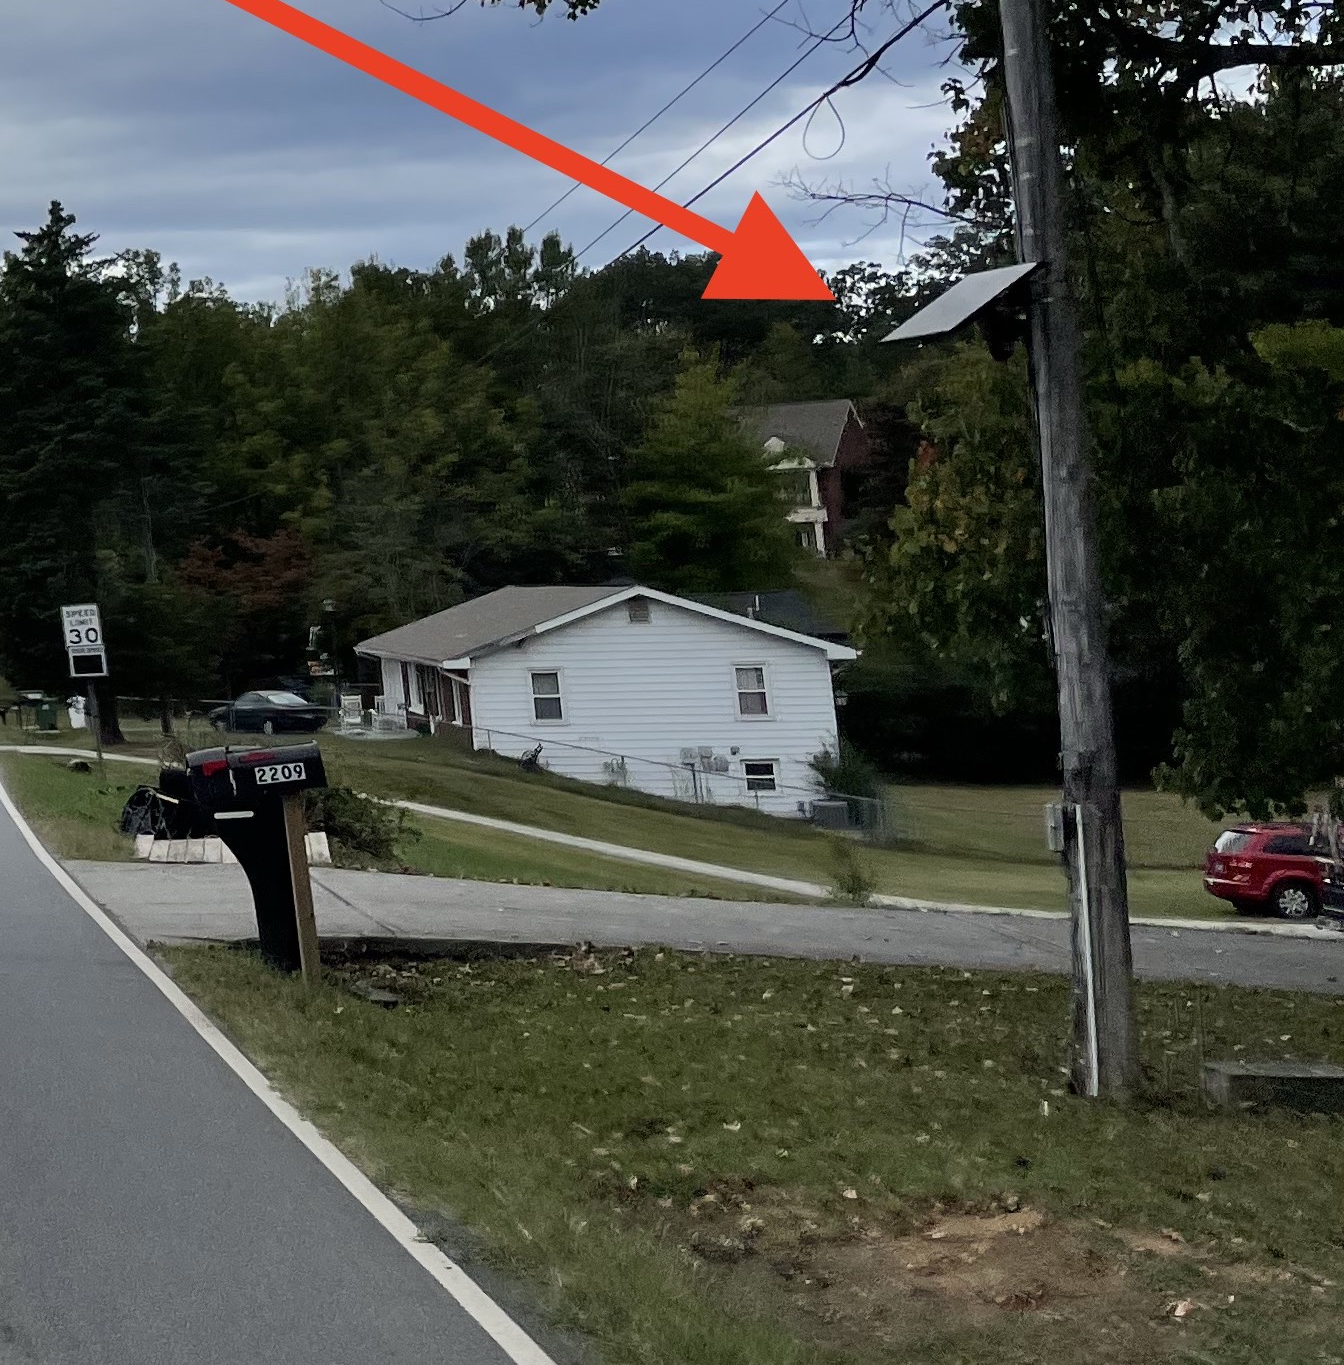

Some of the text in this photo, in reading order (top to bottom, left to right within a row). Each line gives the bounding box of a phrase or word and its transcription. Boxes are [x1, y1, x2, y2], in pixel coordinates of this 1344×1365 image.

[65, 609, 96, 618] SPEED
[69, 628, 98, 644] 30
[257, 764, 304, 783] 2209
